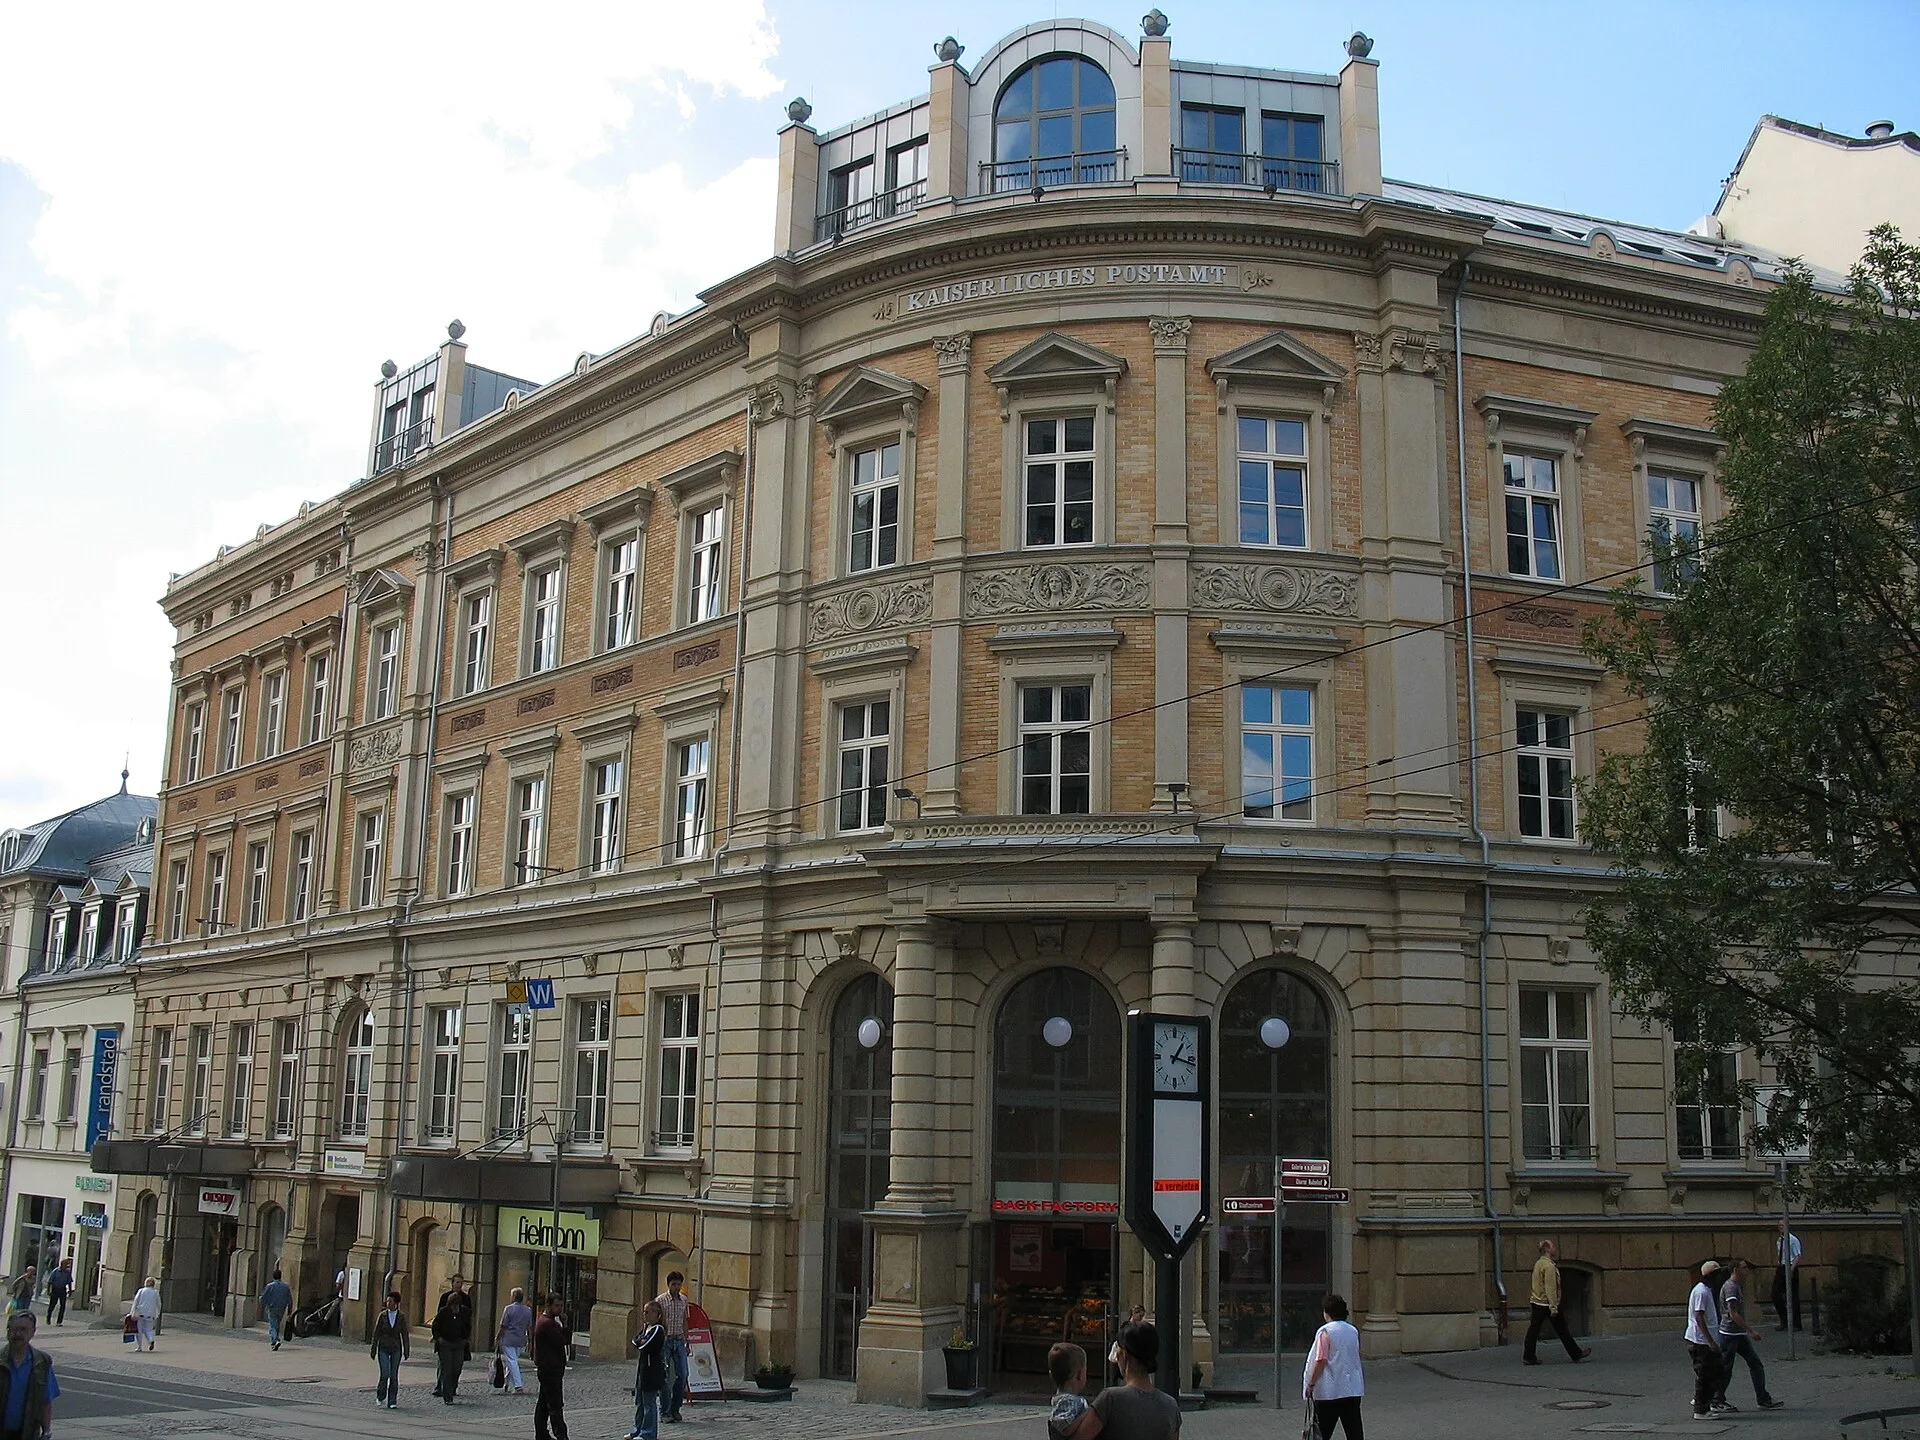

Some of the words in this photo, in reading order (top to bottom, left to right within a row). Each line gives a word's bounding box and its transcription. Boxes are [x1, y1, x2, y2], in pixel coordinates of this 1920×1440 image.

[907, 267, 1096, 312] KAISERLICHES
[1106, 265, 1227, 285] POSTAMT
[529, 984, 551, 1004] W
[96, 1037, 116, 1112] randstad
[1165, 1181, 1199, 1191] vermieten
[992, 1199, 1118, 1213] BACK-FACTORY
[518, 1216, 585, 1251] fielmann
